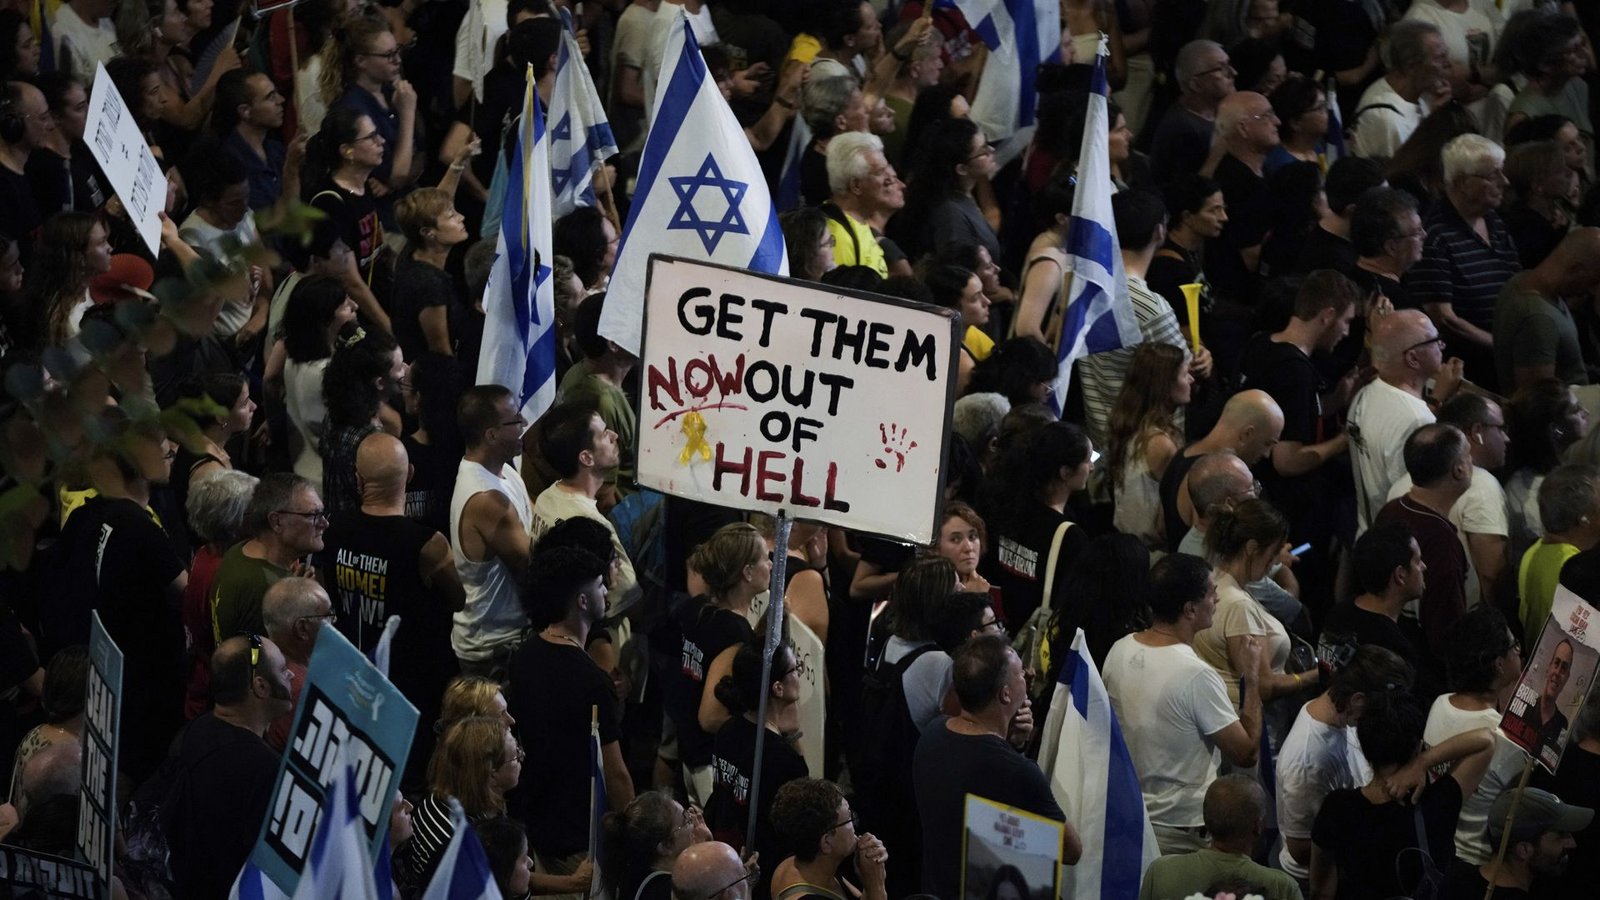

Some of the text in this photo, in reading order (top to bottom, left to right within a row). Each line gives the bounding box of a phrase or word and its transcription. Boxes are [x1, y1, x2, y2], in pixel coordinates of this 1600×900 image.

[677, 287, 937, 381] GET THEM
[648, 353, 854, 416] NOW OUT
[759, 410, 824, 453] OF
[712, 440, 850, 513] HELL
[336, 547, 354, 567] ALL
[360, 553, 388, 576] THEM
[336, 564, 386, 601] HOME!
[337, 589, 386, 629] NW!
[87, 663, 114, 750] SEAL
[1508, 699, 1528, 718] HIM
[1515, 683, 1539, 708] BRING
[85, 730, 108, 812] THE
[77, 788, 108, 882] DEAL
